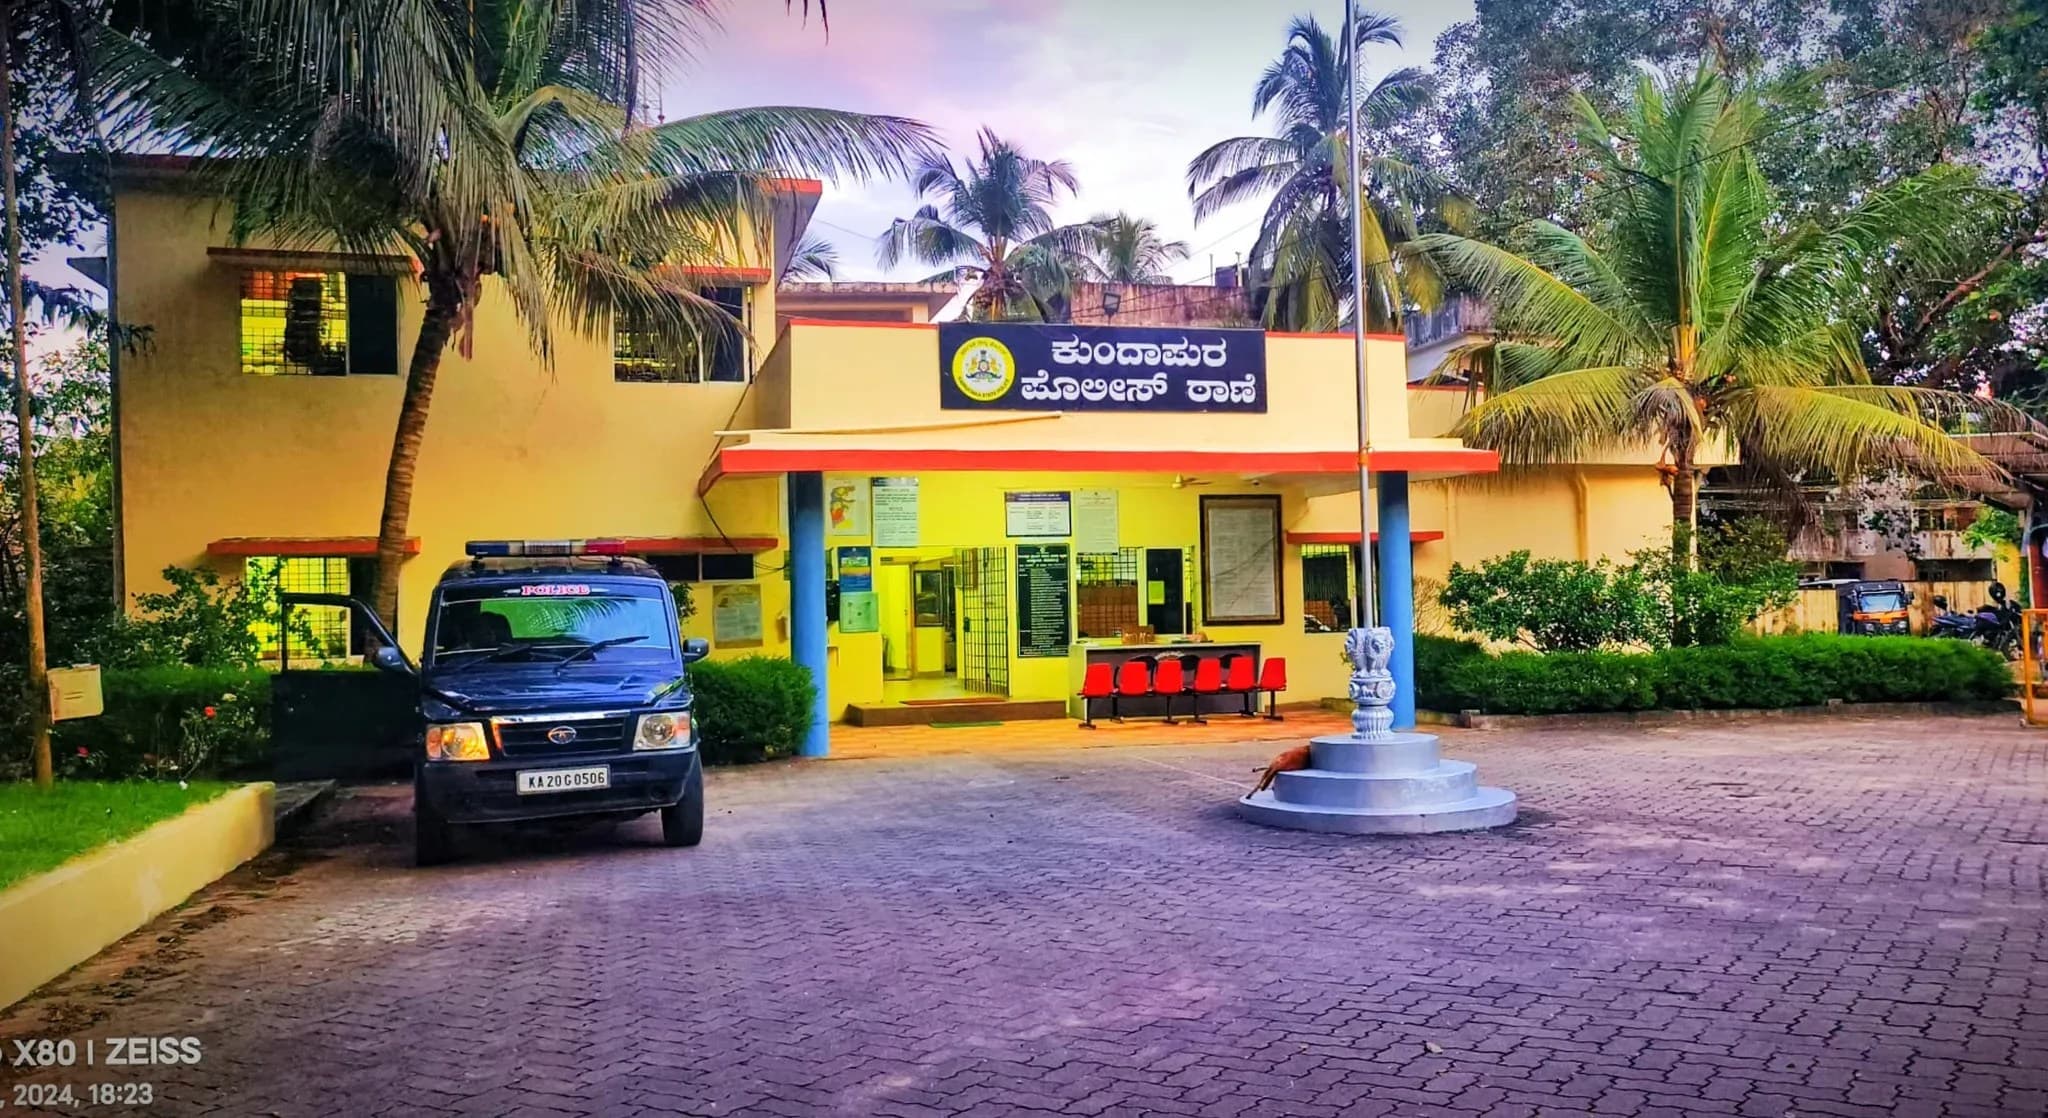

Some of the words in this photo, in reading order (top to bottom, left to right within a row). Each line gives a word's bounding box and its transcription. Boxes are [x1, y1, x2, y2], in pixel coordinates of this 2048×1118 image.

[1051, 333, 1227, 368] ಕುಂದಾಪುರ
[1020, 369, 1168, 402] ಪೊಲೀಸ್
[1186, 373, 1256, 403] ಠಾಣೆ
[521, 584, 592, 596] POLICE
